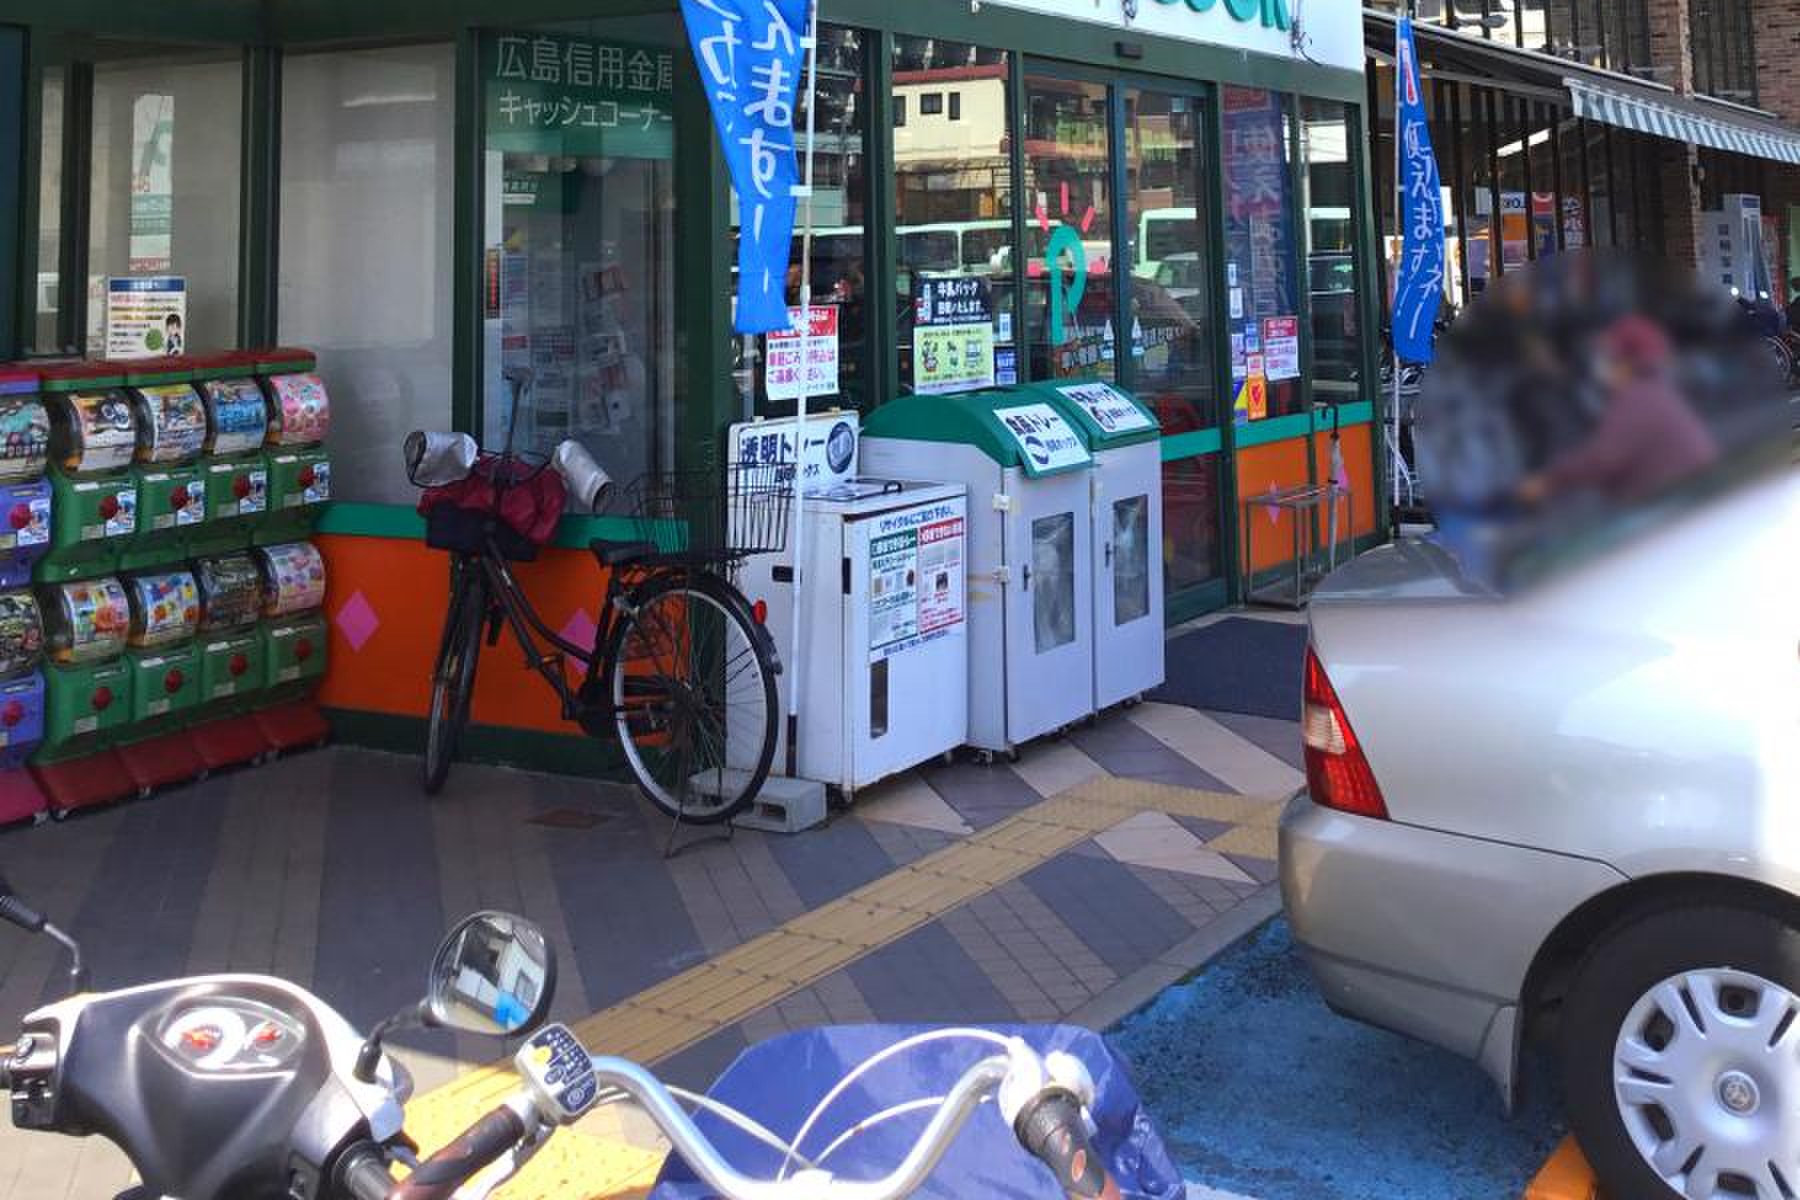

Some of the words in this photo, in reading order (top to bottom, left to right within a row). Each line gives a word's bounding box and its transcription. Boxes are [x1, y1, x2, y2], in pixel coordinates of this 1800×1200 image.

[500, 88, 673, 132] キャッシュコーナー
